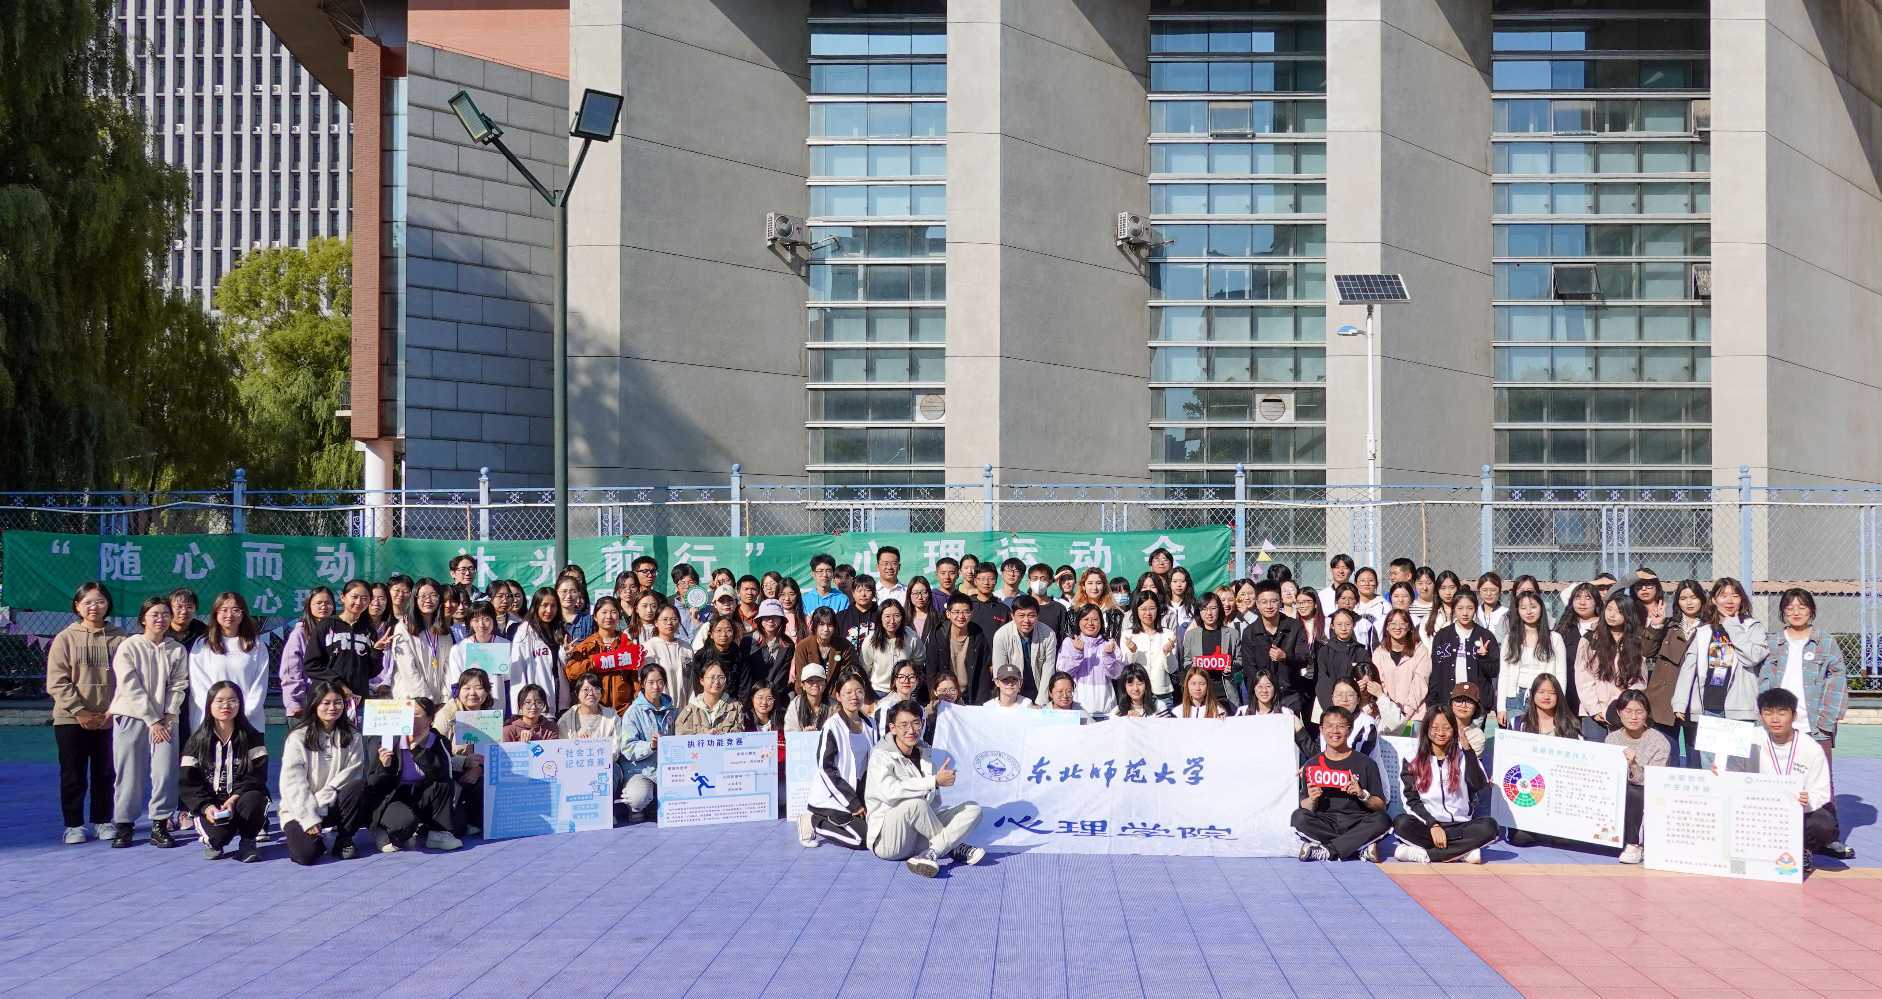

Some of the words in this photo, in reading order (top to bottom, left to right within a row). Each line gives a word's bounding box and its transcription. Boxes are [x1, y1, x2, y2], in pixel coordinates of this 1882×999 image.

[1196, 657, 1225, 669] GOOD
[1027, 756, 1206, 788] 东北师范大学
[1314, 770, 1348, 786] GOOD
[994, 815, 1239, 840] 心理学院
